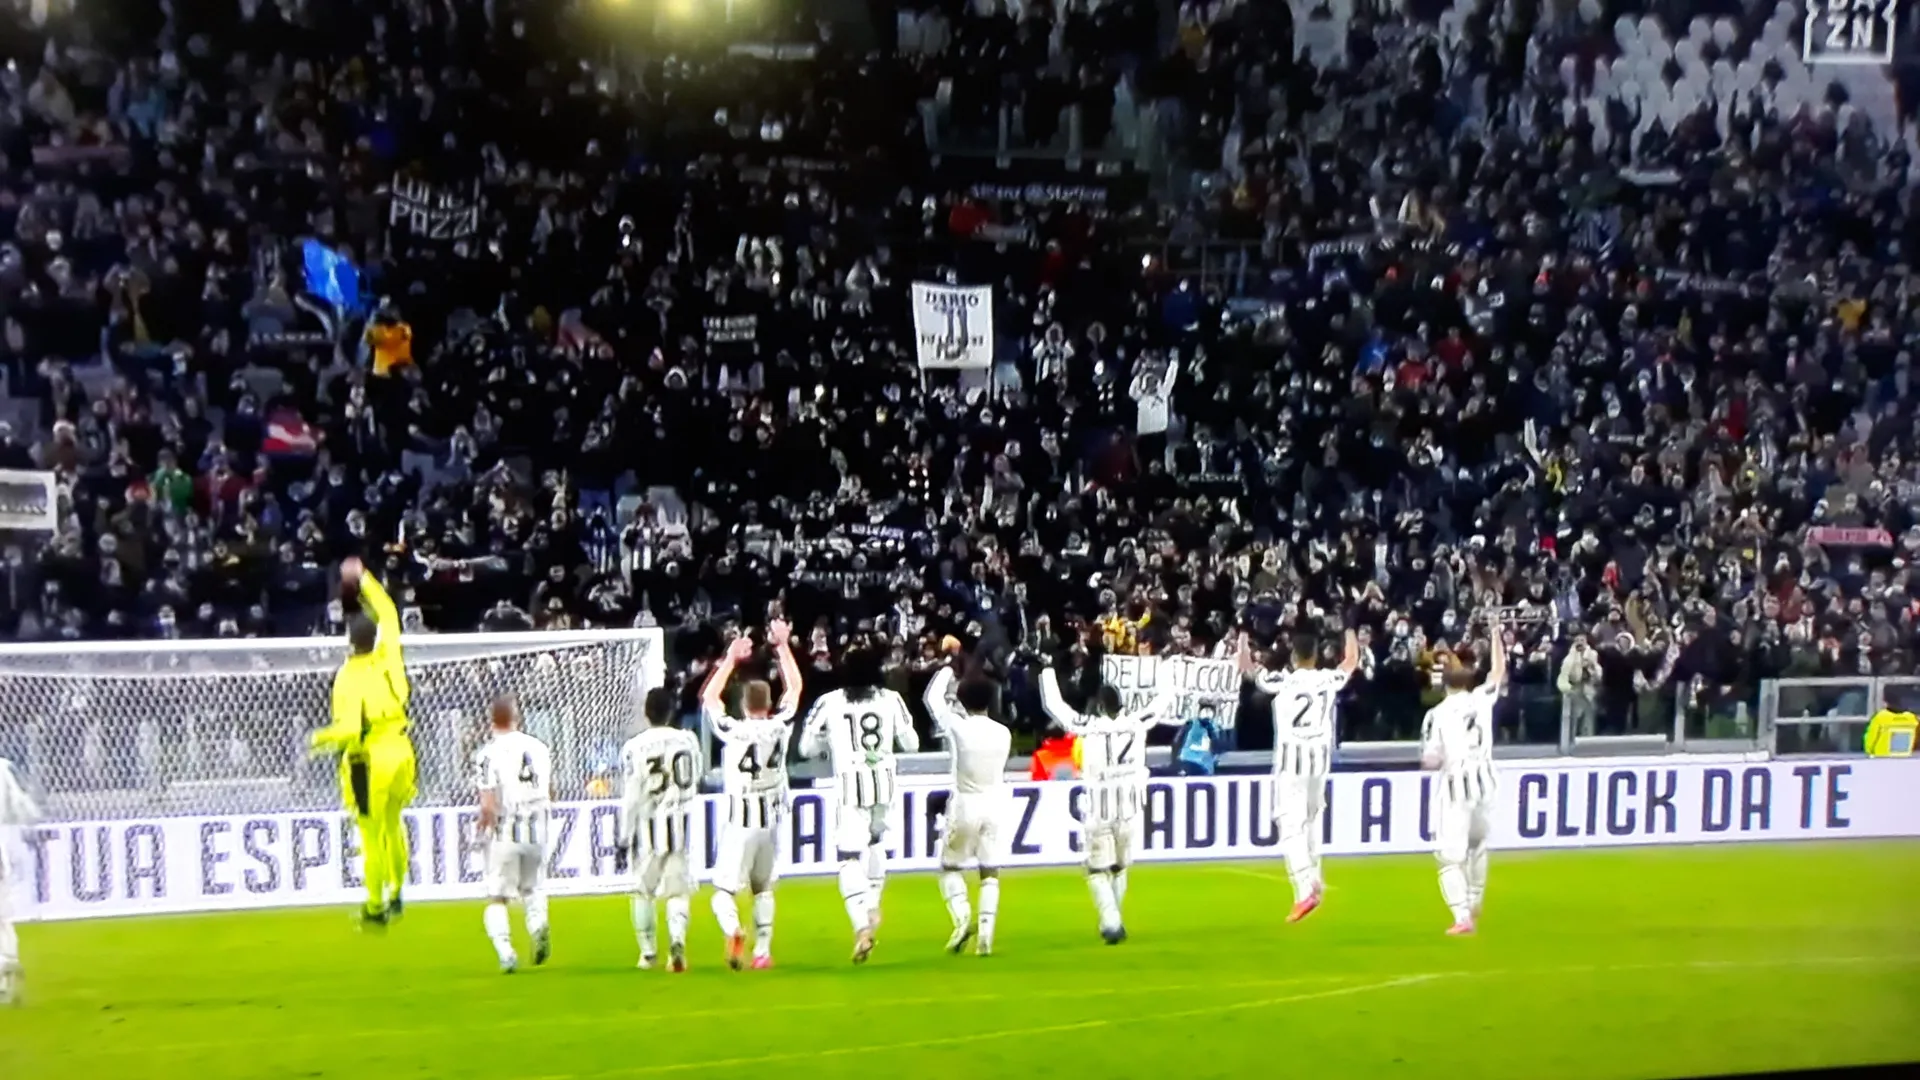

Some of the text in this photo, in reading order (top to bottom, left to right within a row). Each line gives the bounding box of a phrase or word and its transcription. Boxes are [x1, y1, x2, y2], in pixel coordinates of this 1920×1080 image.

[1292, 690, 1328, 728] 21
[843, 712, 883, 752] 18
[1105, 731, 1135, 767] 12
[518, 751, 539, 789] 4
[646, 750, 693, 795] 30
[22, 823, 167, 903] TUA
[200, 803, 632, 896] ESPEIEZA
[1360, 777, 1393, 843] A
[1517, 769, 1677, 838] CLICK
[1701, 766, 1772, 832] DA
[1793, 764, 1853, 829] TE
